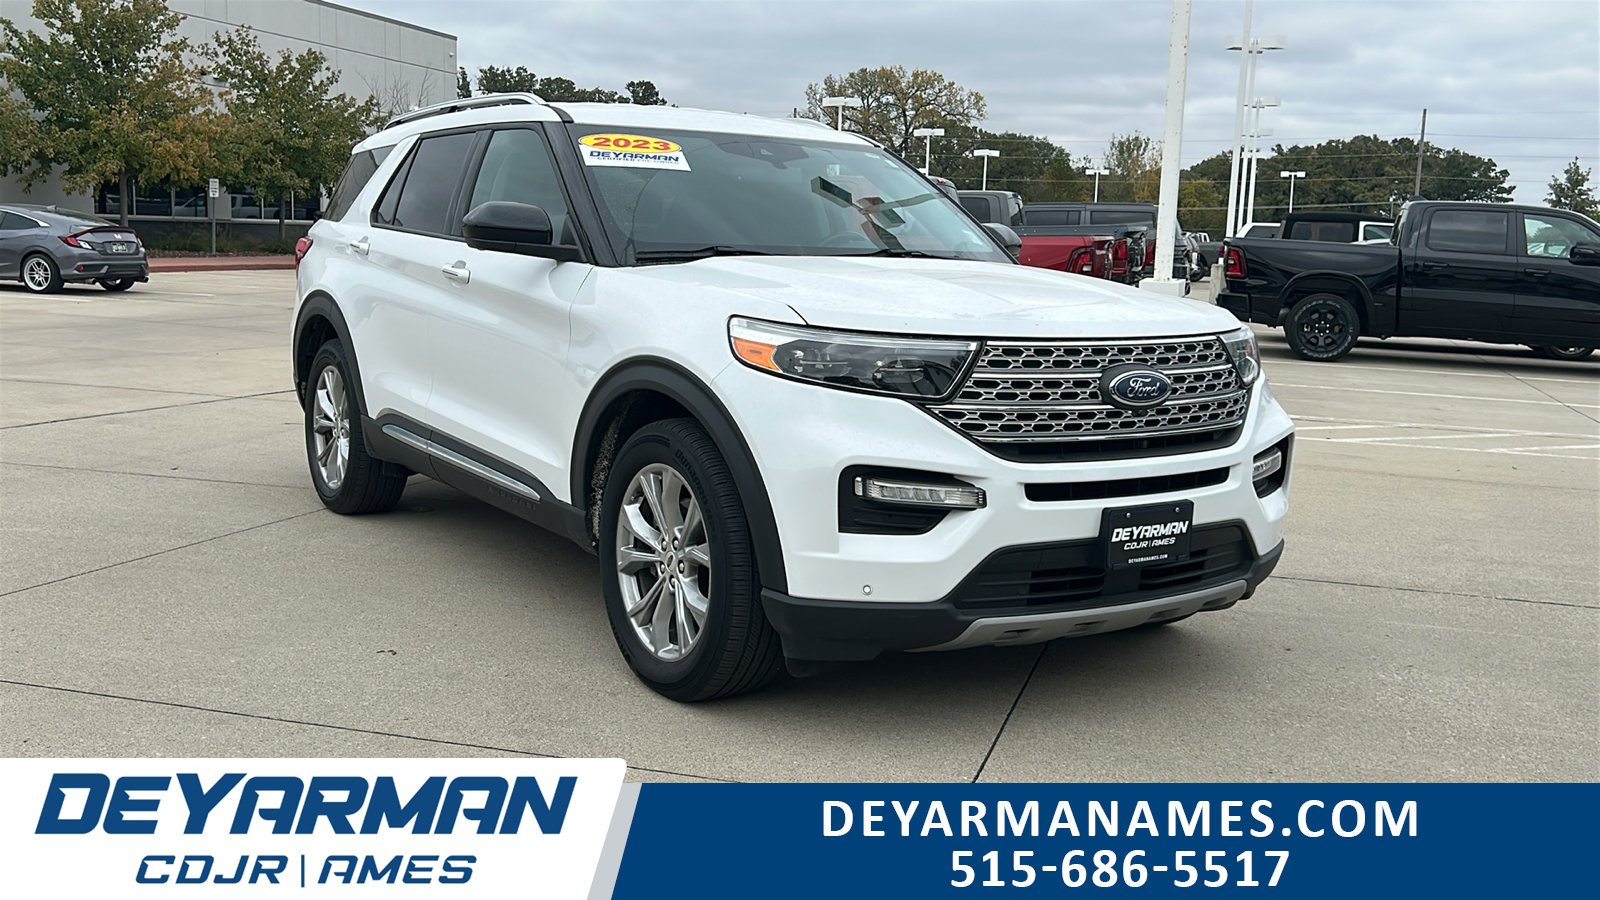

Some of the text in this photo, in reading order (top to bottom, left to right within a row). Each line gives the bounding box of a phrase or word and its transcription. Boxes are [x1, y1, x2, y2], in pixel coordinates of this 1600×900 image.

[593, 137, 671, 150] 2023
[589, 150, 680, 162] DEYARMAN
[1127, 377, 1160, 398] Ford
[1111, 521, 1189, 542] DEYARMAN
[1123, 537, 1176, 550] CDJR AMES
